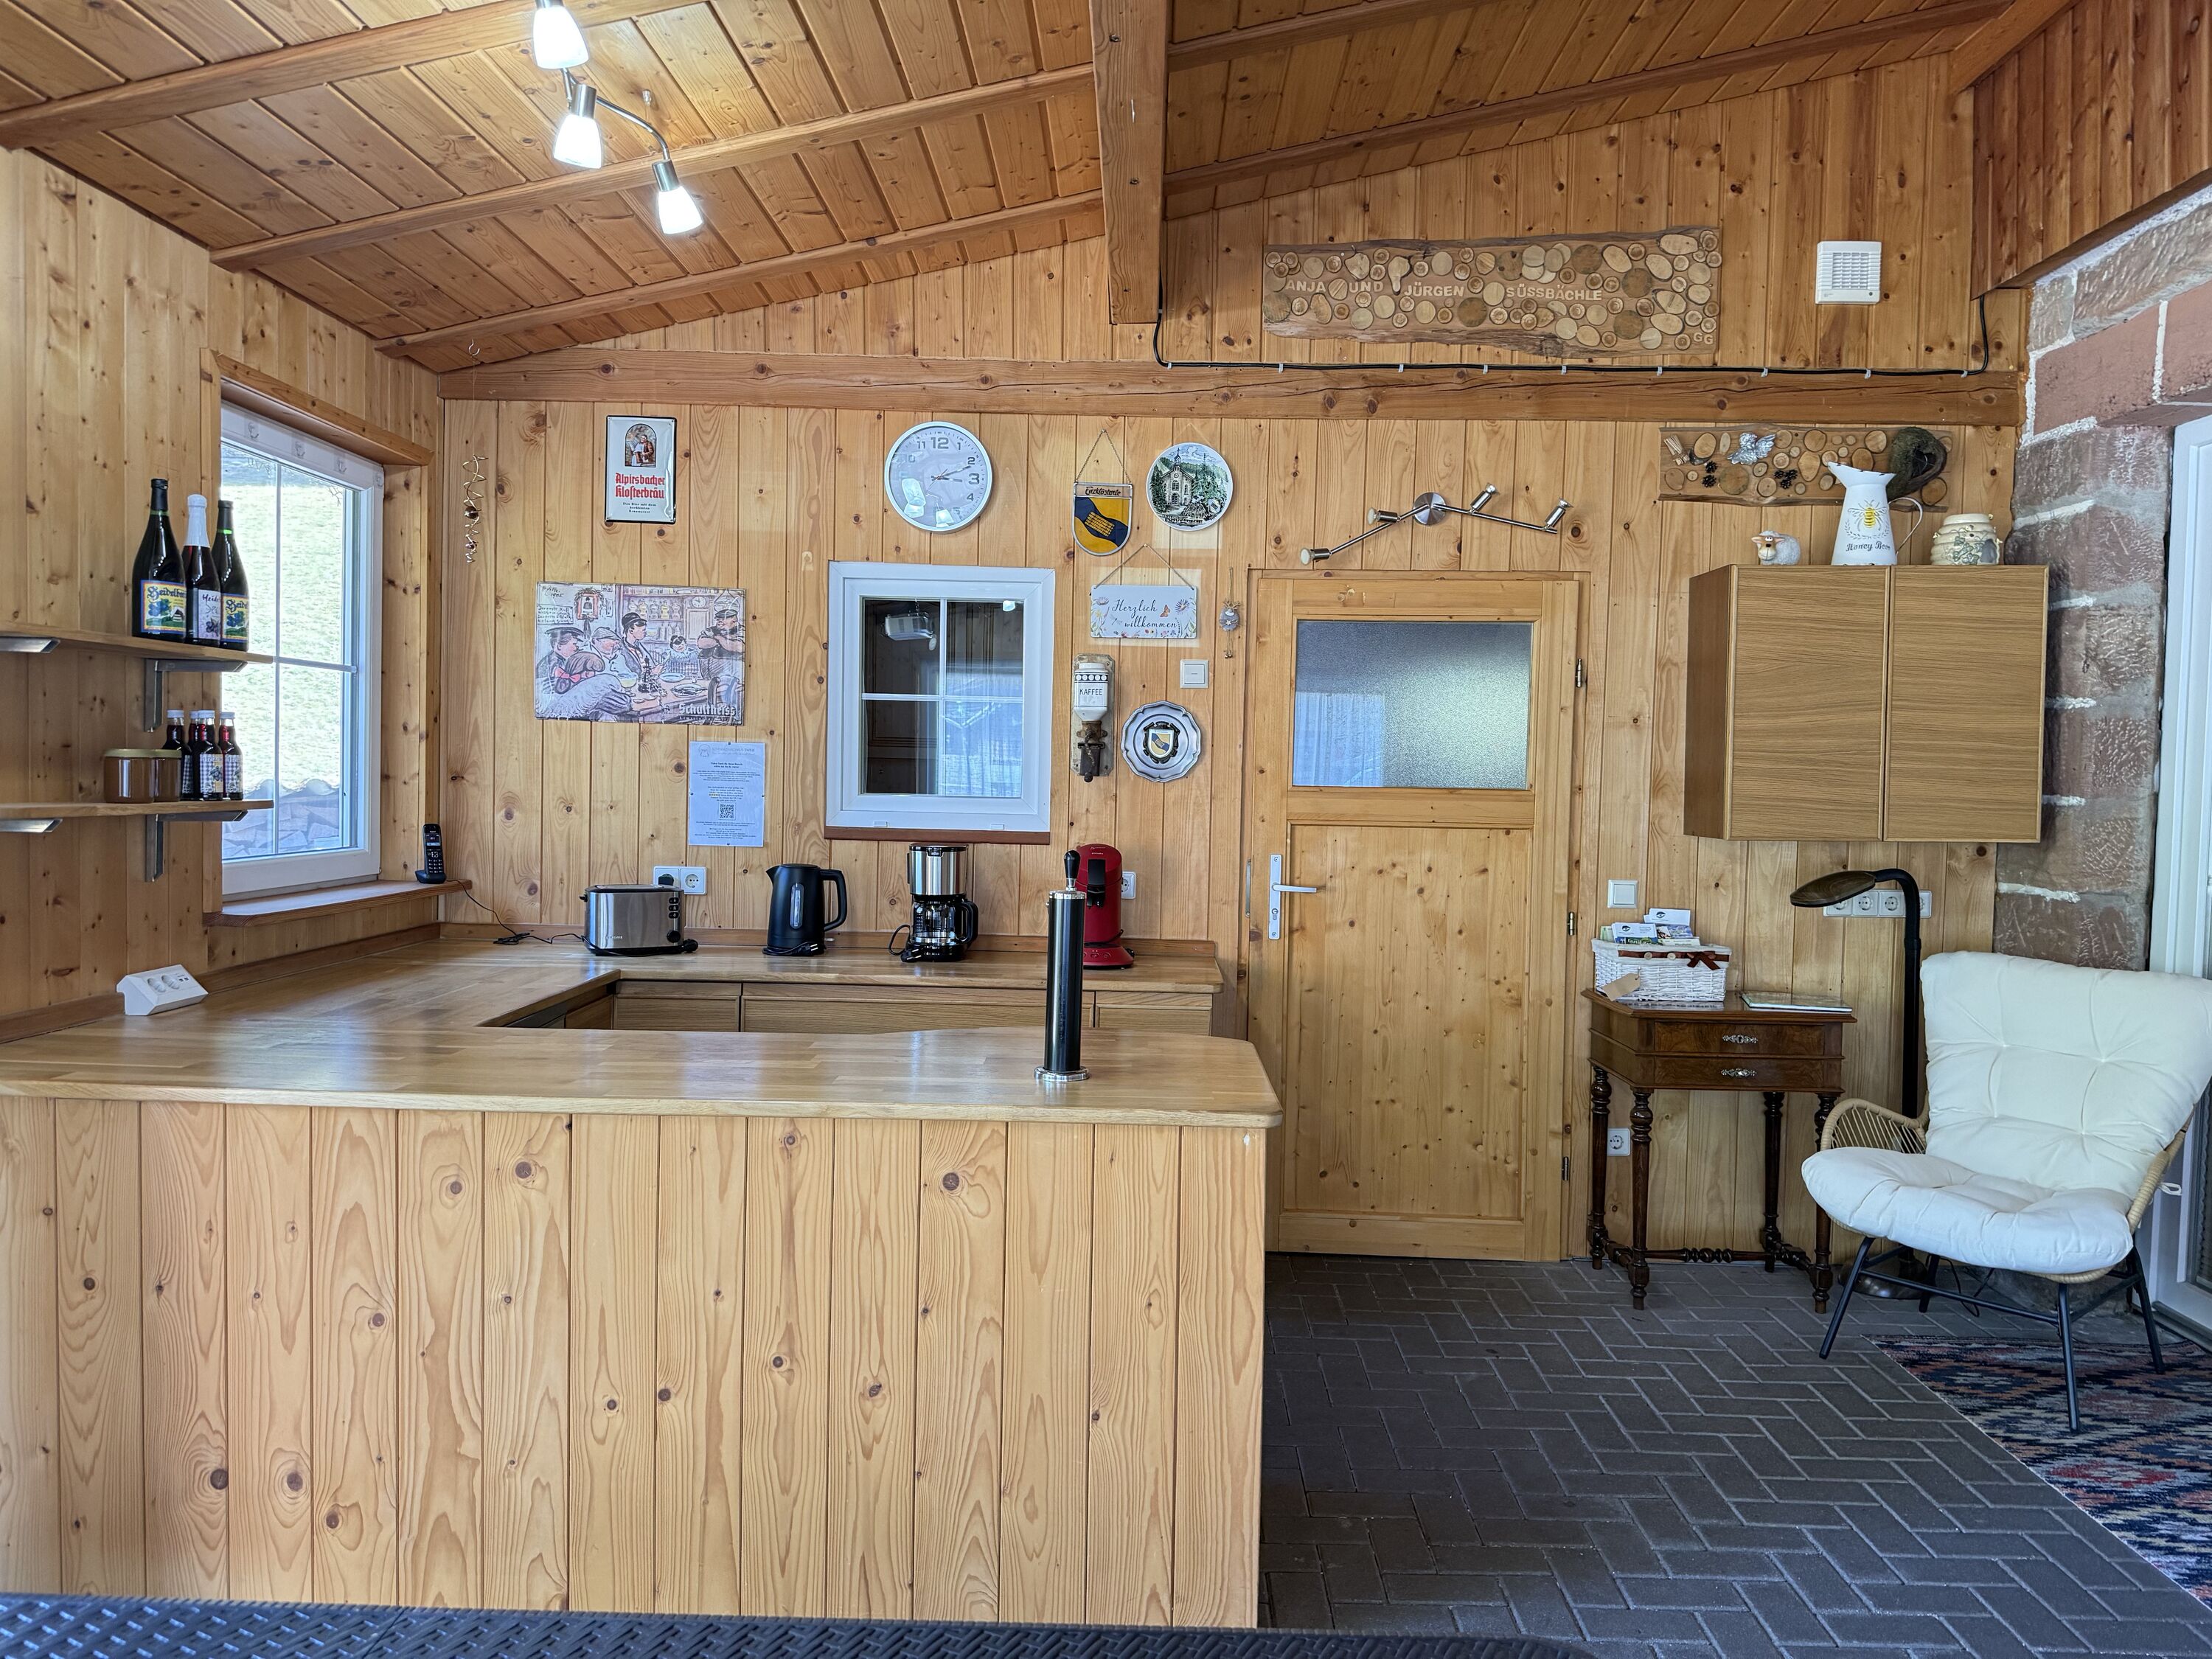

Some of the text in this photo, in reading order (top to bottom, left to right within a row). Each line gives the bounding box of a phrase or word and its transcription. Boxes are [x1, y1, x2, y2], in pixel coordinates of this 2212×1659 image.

[1284, 279, 1602, 302] ANJA UND JÜRGEN SÜSSBÄCHLE
[917, 441, 926, 449] 11
[931, 437, 949, 449] 12
[957, 442, 961, 451] 1
[967, 456, 975, 465] 2
[615, 472, 665, 486] Alpirsbacher
[968, 473, 980, 485] 3
[615, 484, 665, 500] Klosterbräu
[966, 493, 974, 501] 4
[1846, 543, 1873, 552] Honey
[1111, 599, 1158, 619] Herzlich
[1124, 615, 1178, 627] willkommen
[1079, 688, 1103, 696] KAFFEE
[678, 703, 737, 716] Schultheiss
